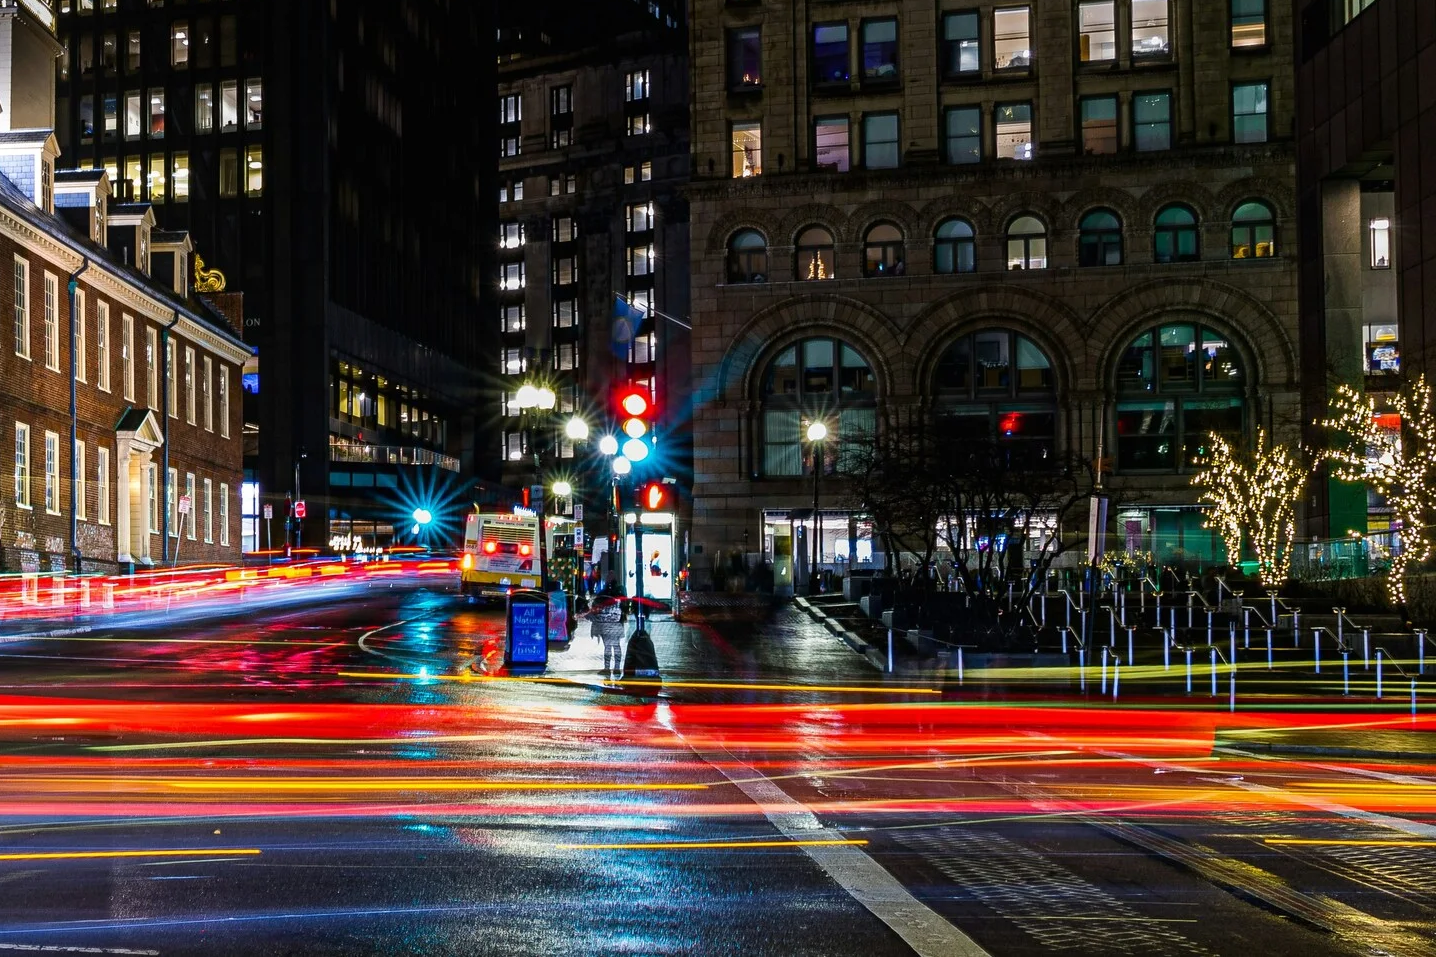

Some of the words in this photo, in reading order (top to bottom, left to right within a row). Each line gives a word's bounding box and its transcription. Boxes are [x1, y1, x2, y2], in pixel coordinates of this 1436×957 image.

[245, 318, 261, 327] ON
[524, 608, 535, 617] All
[514, 615, 544, 624] Natural
